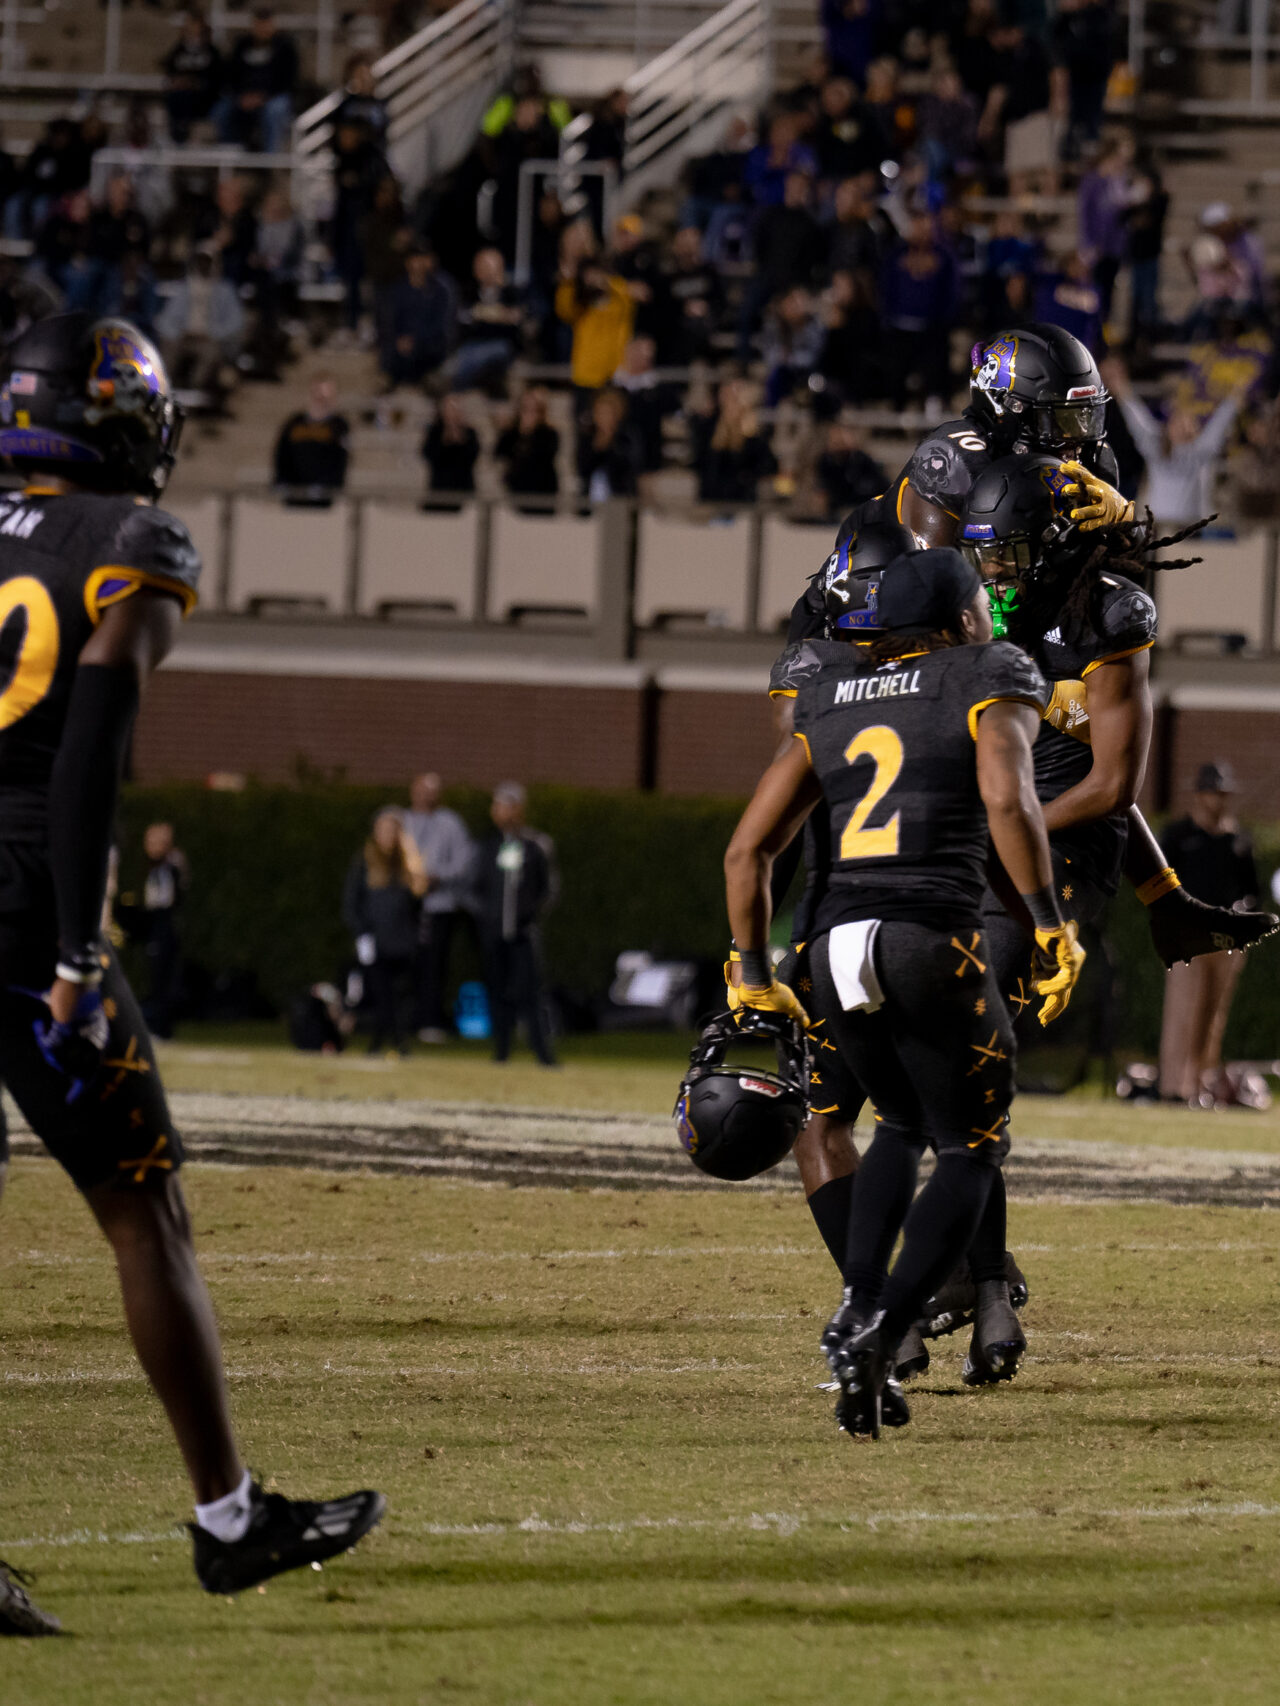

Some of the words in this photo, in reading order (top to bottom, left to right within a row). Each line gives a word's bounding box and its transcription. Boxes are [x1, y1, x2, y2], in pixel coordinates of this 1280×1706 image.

[993, 342, 1011, 356] ECU
[948, 430, 987, 450] 10
[834, 670, 921, 704] MITCHELL
[840, 724, 904, 861] 2
